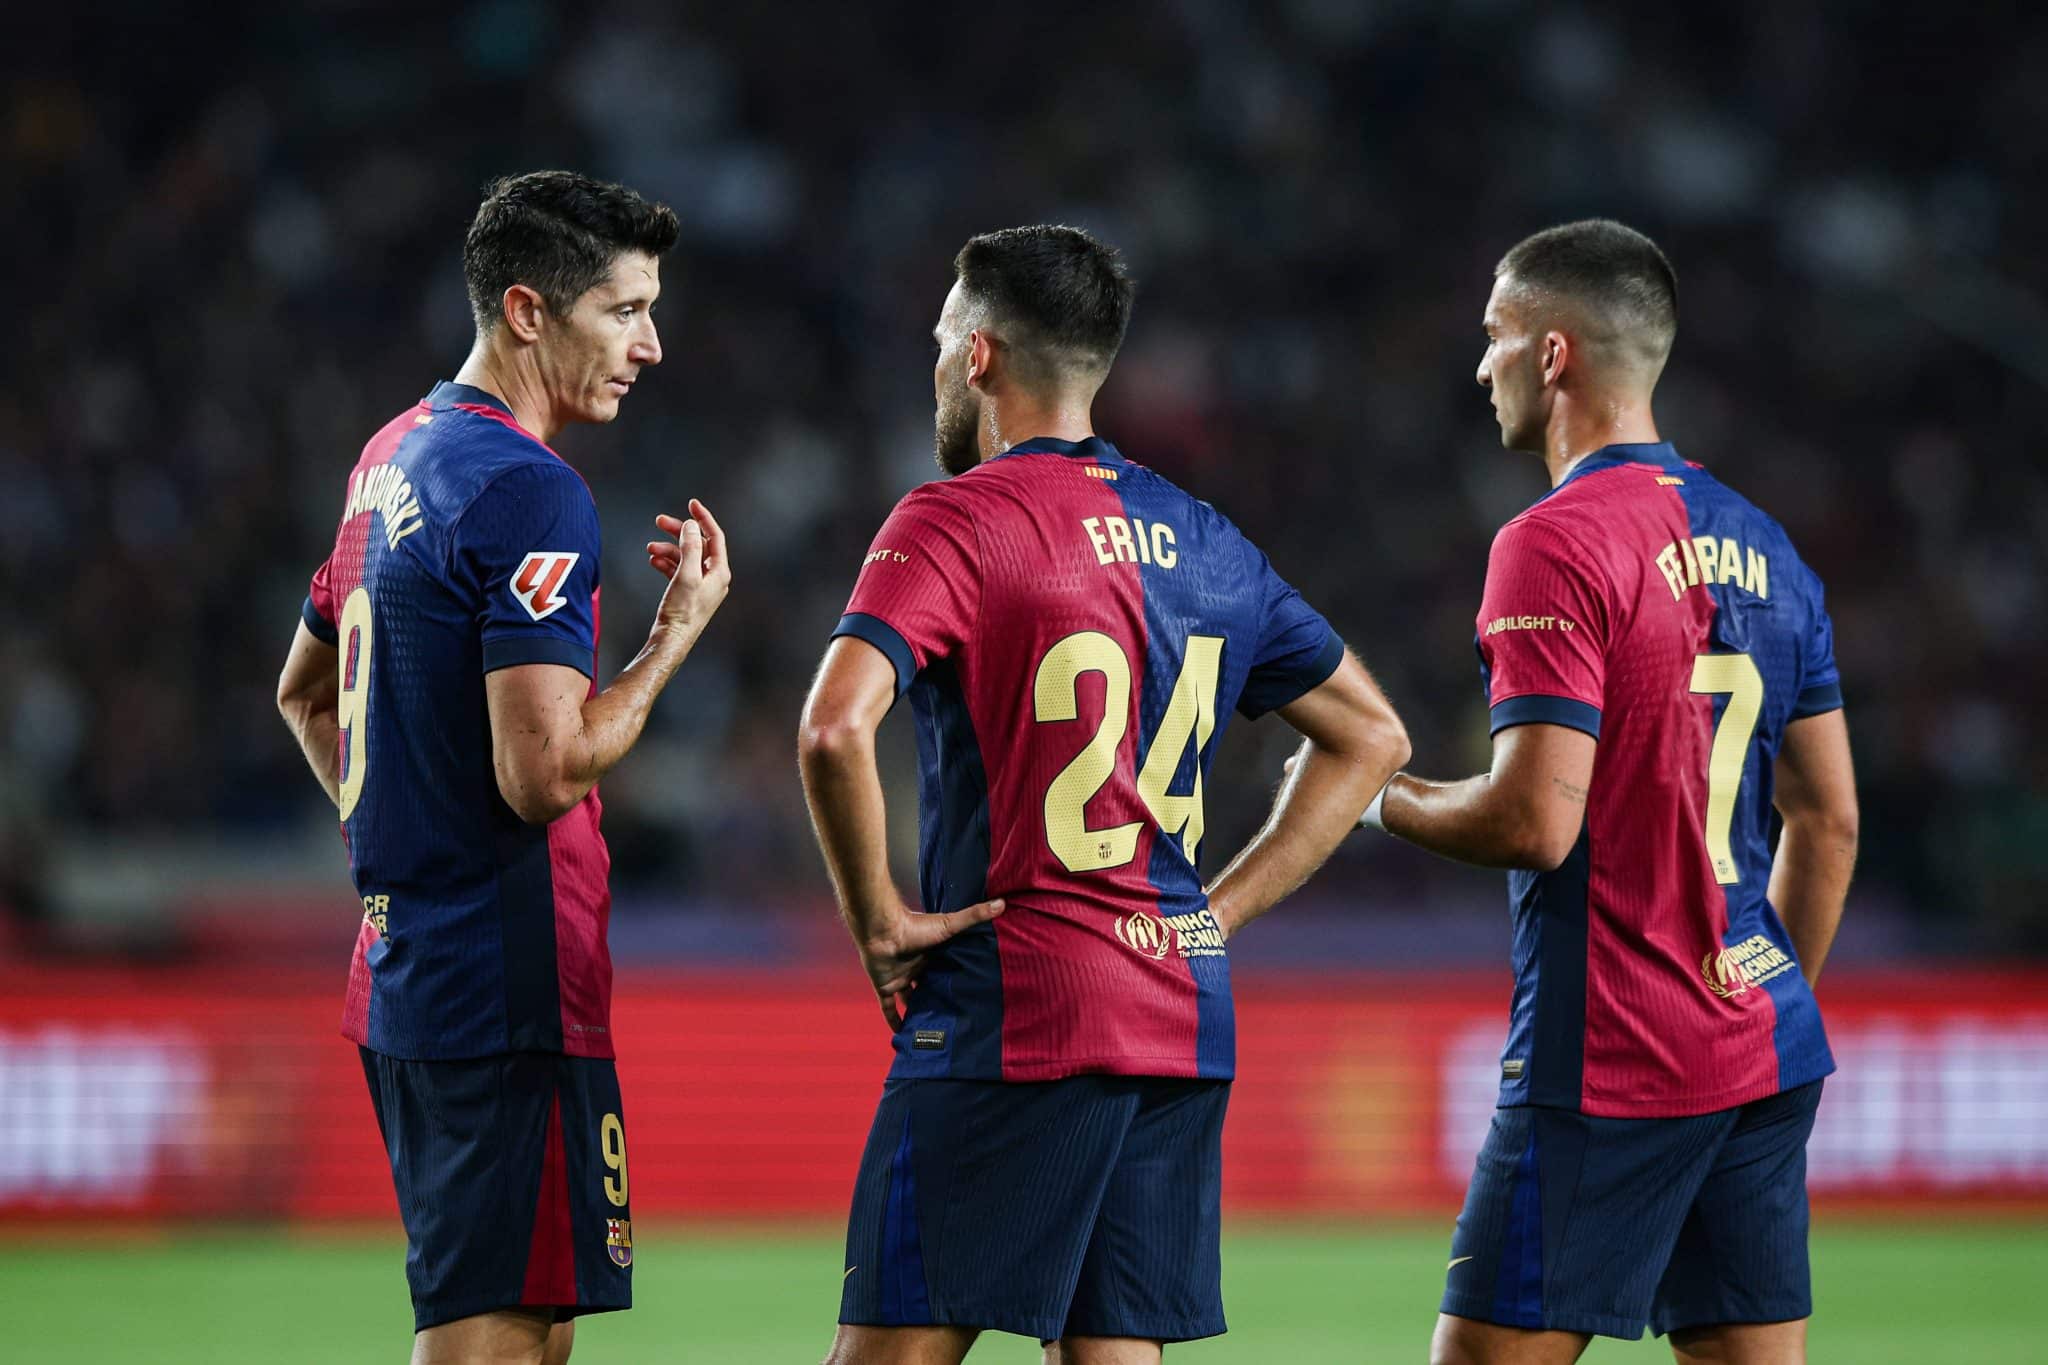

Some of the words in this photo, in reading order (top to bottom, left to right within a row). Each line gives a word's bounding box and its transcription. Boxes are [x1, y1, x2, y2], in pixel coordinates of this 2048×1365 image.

[893, 551, 910, 563] tv
[1082, 516, 1178, 569] ERIC
[1486, 616, 1555, 636] AMBILIGHT
[1558, 619, 1575, 632] tv
[338, 586, 373, 822] 9
[1034, 631, 1226, 872] 24
[1689, 654, 1764, 885] 7
[1738, 948, 1790, 983] ACNUR
[601, 1112, 629, 1207] 9
